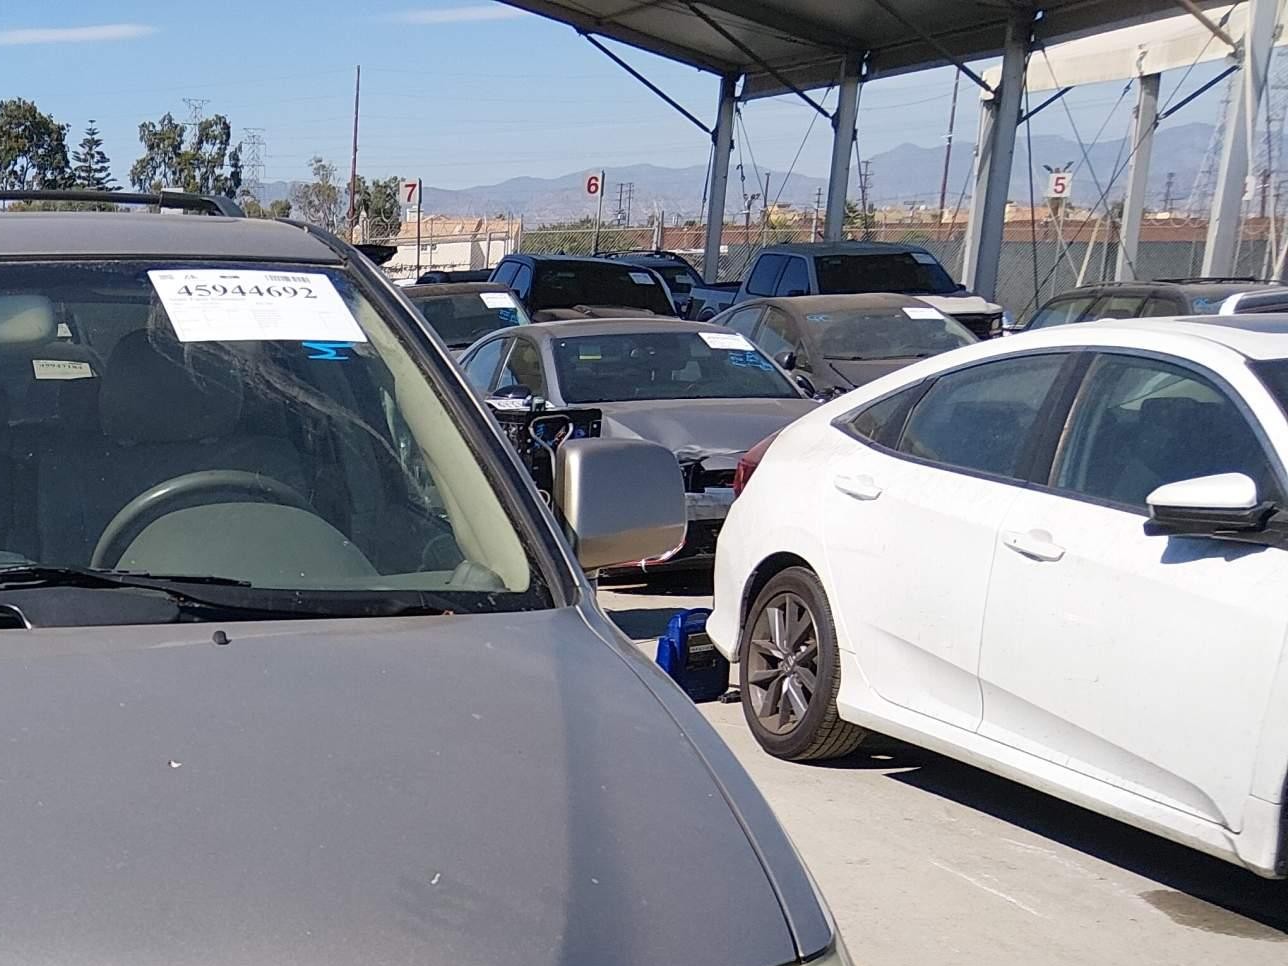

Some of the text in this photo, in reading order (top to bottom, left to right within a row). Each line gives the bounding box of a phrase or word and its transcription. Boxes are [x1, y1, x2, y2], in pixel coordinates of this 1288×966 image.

[404, 183, 417, 202] 7
[587, 176, 599, 194] 6
[1054, 176, 1066, 194] 5
[177, 284, 318, 299] 45944692
